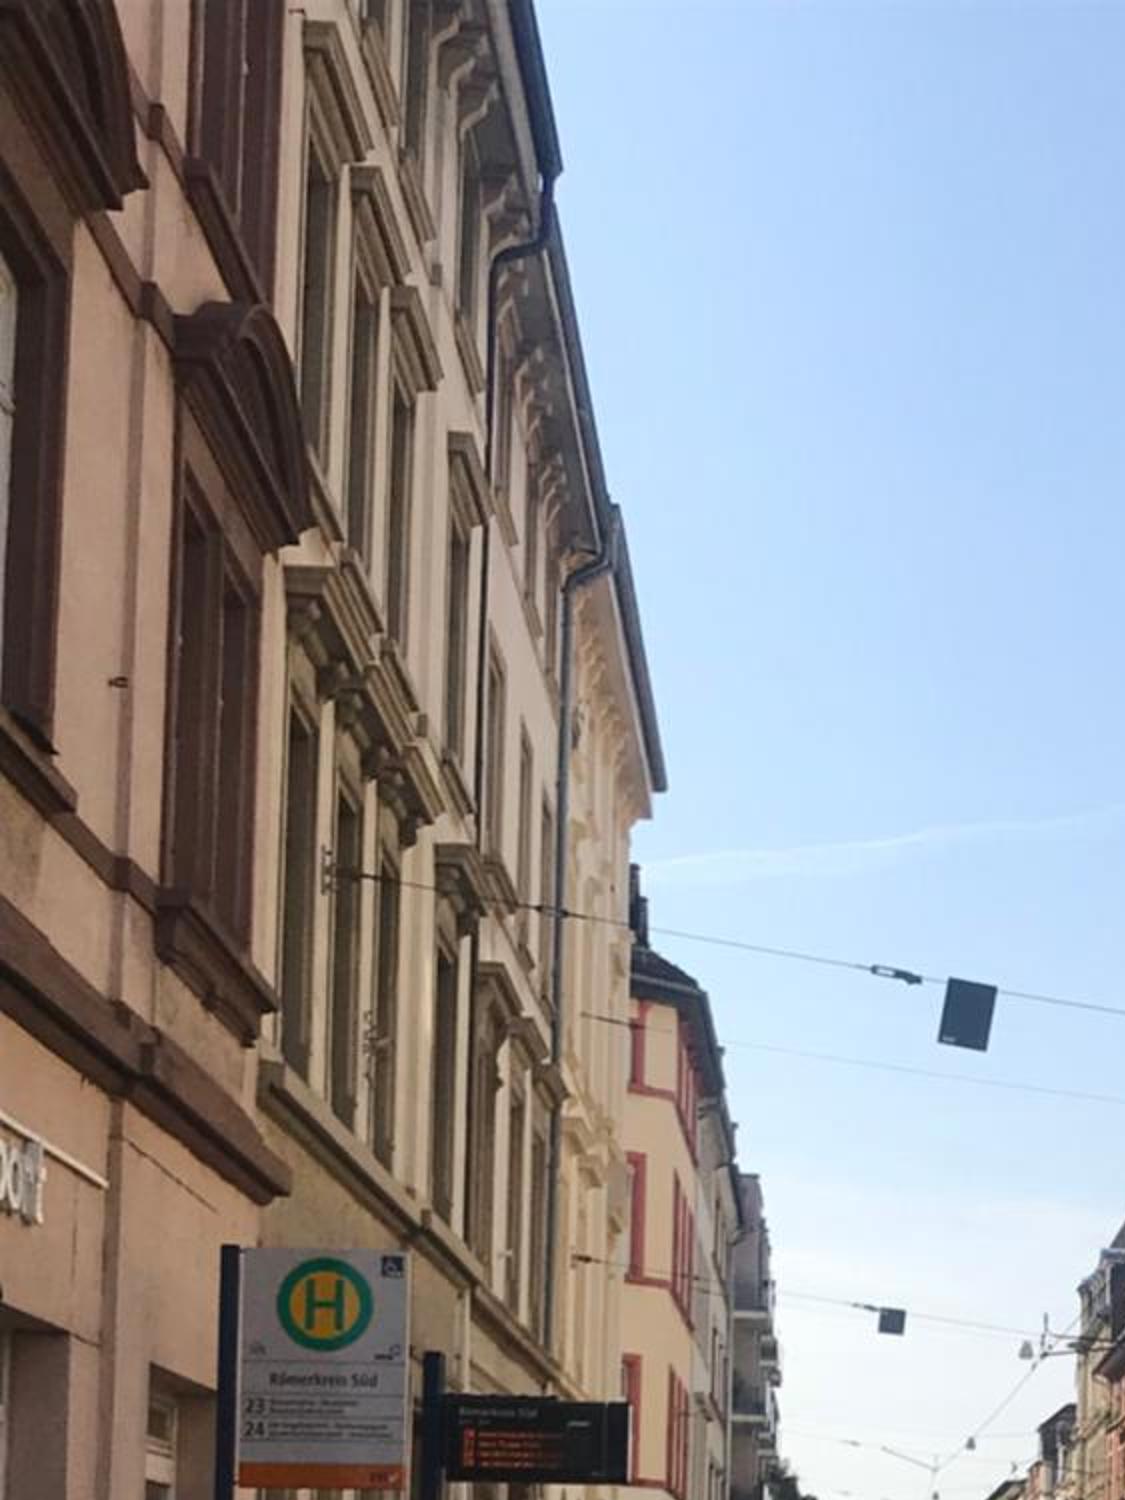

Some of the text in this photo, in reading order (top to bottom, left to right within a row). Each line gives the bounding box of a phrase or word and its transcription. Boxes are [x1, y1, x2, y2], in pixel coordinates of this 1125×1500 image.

[304, 1279, 346, 1331] H
[245, 1398, 266, 1414] 23
[244, 1421, 265, 1437] 24
